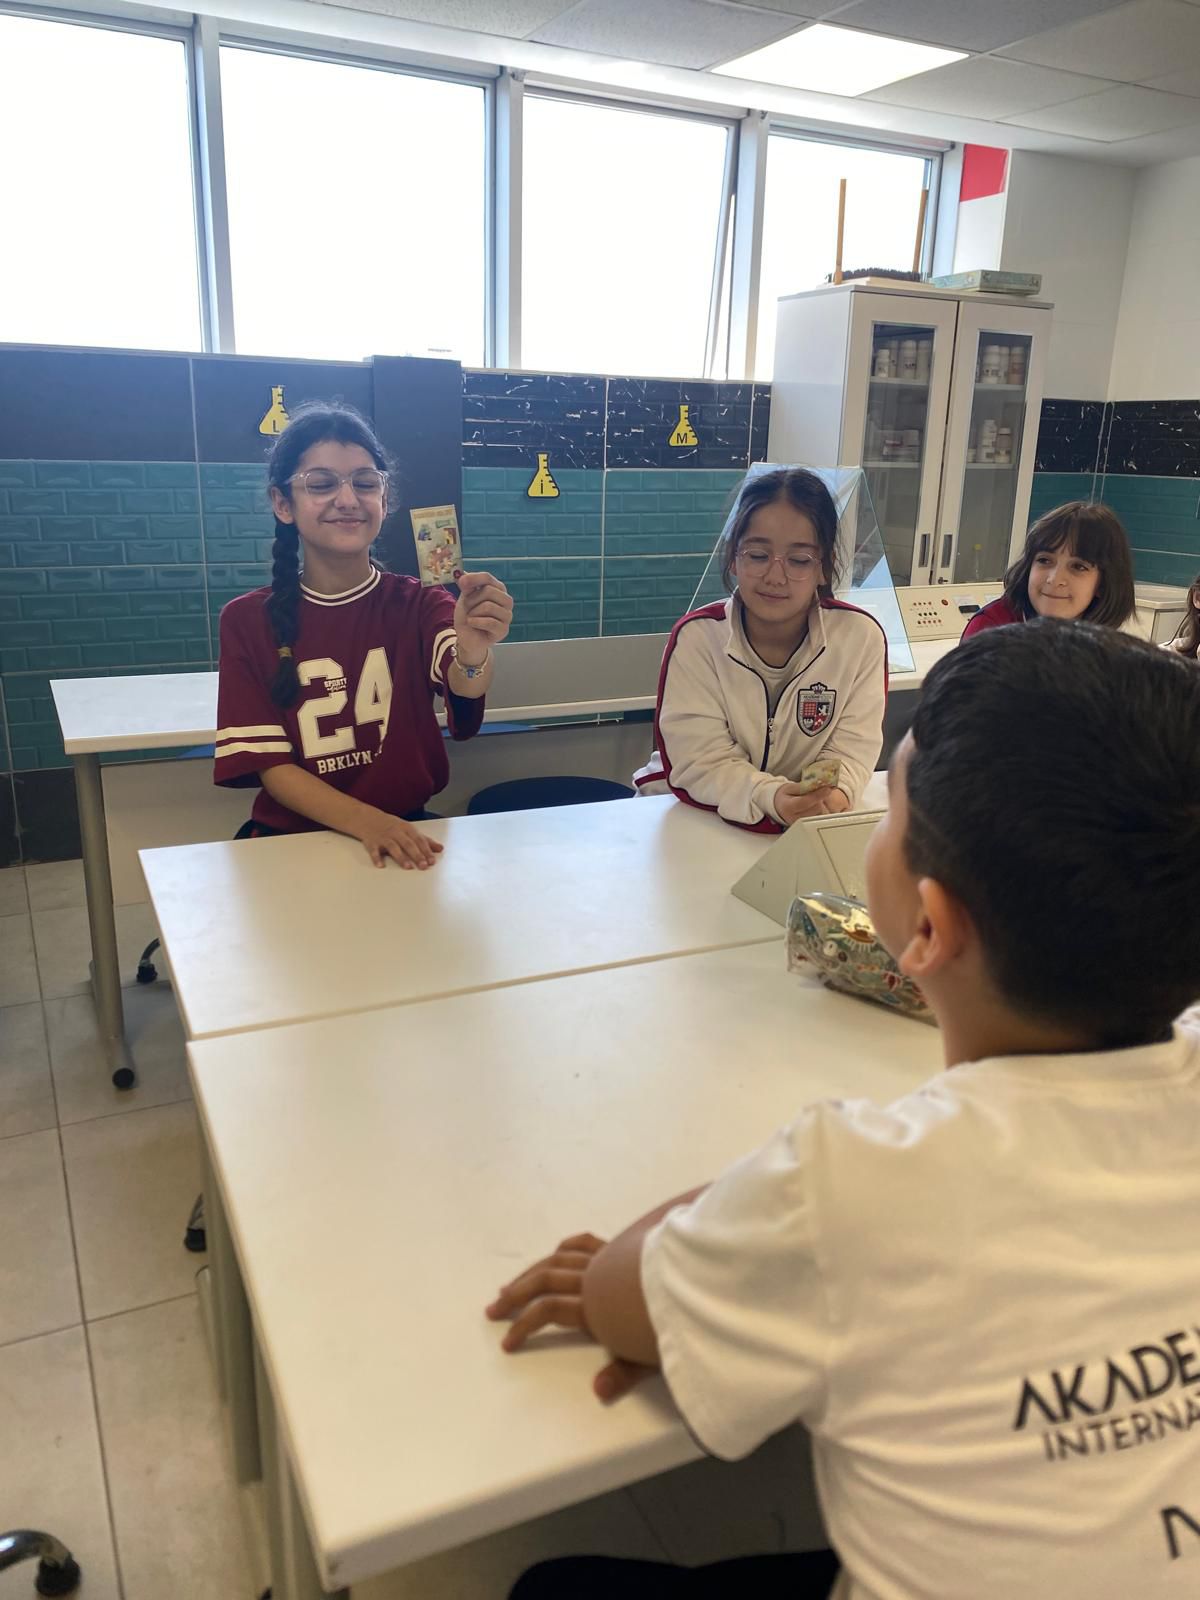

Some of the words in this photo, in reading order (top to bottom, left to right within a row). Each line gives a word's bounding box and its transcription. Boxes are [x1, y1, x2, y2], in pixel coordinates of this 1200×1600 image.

[676, 432, 688, 445] M
[296, 646, 394, 759] 24
[316, 750, 373, 775] BRKLYN
[1011, 1323, 1200, 1432] AKADE
[1042, 1390, 1200, 1462] INTERNA
